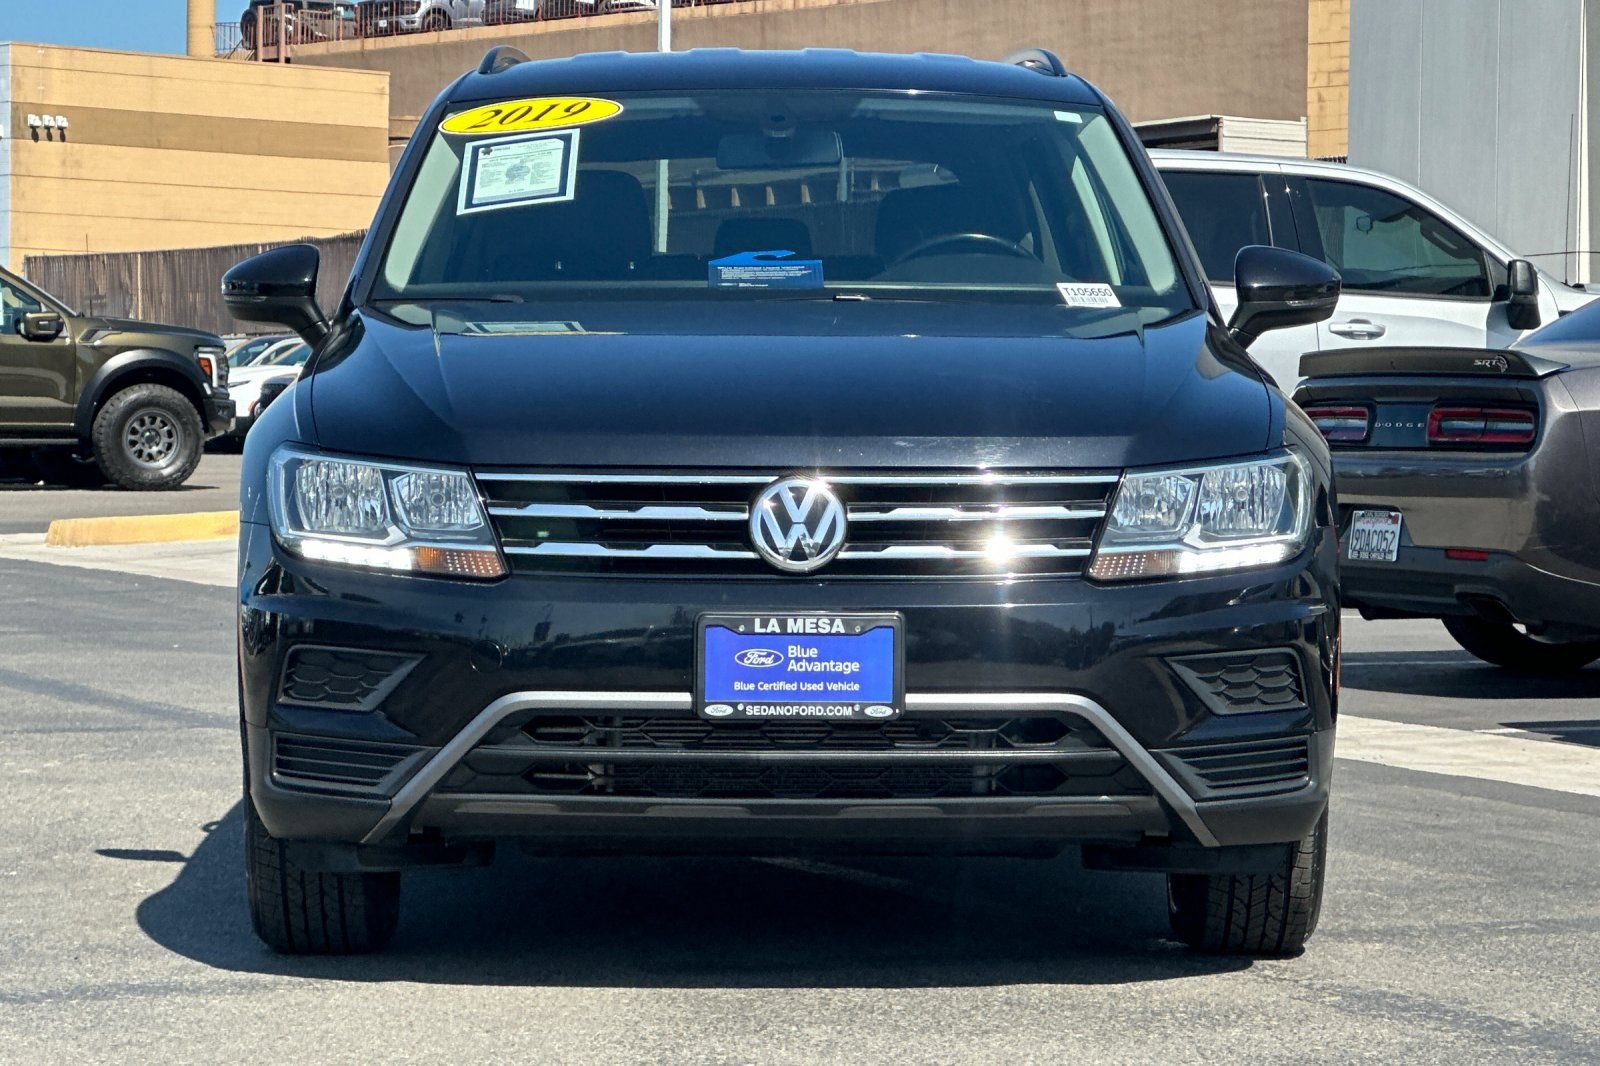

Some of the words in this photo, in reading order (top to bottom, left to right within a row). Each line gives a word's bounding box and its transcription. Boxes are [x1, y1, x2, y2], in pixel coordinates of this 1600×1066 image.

[465, 101, 591, 130] 2019
[1062, 287, 1112, 297] T105650
[1473, 359, 1499, 368] SRT
[754, 618, 781, 633] LA
[787, 618, 846, 633] MESA
[788, 645, 818, 658] Blue
[743, 651, 775, 665] Ford
[787, 659, 860, 675] Advantage
[734, 681, 755, 691] Blue
[757, 681, 797, 691] Certified
[800, 681, 824, 691] Used
[826, 681, 860, 691] Vehicle
[709, 705, 728, 714] Ford
[745, 705, 852, 716] SEDANOFORD.COM
[868, 706, 887, 715] Ford
